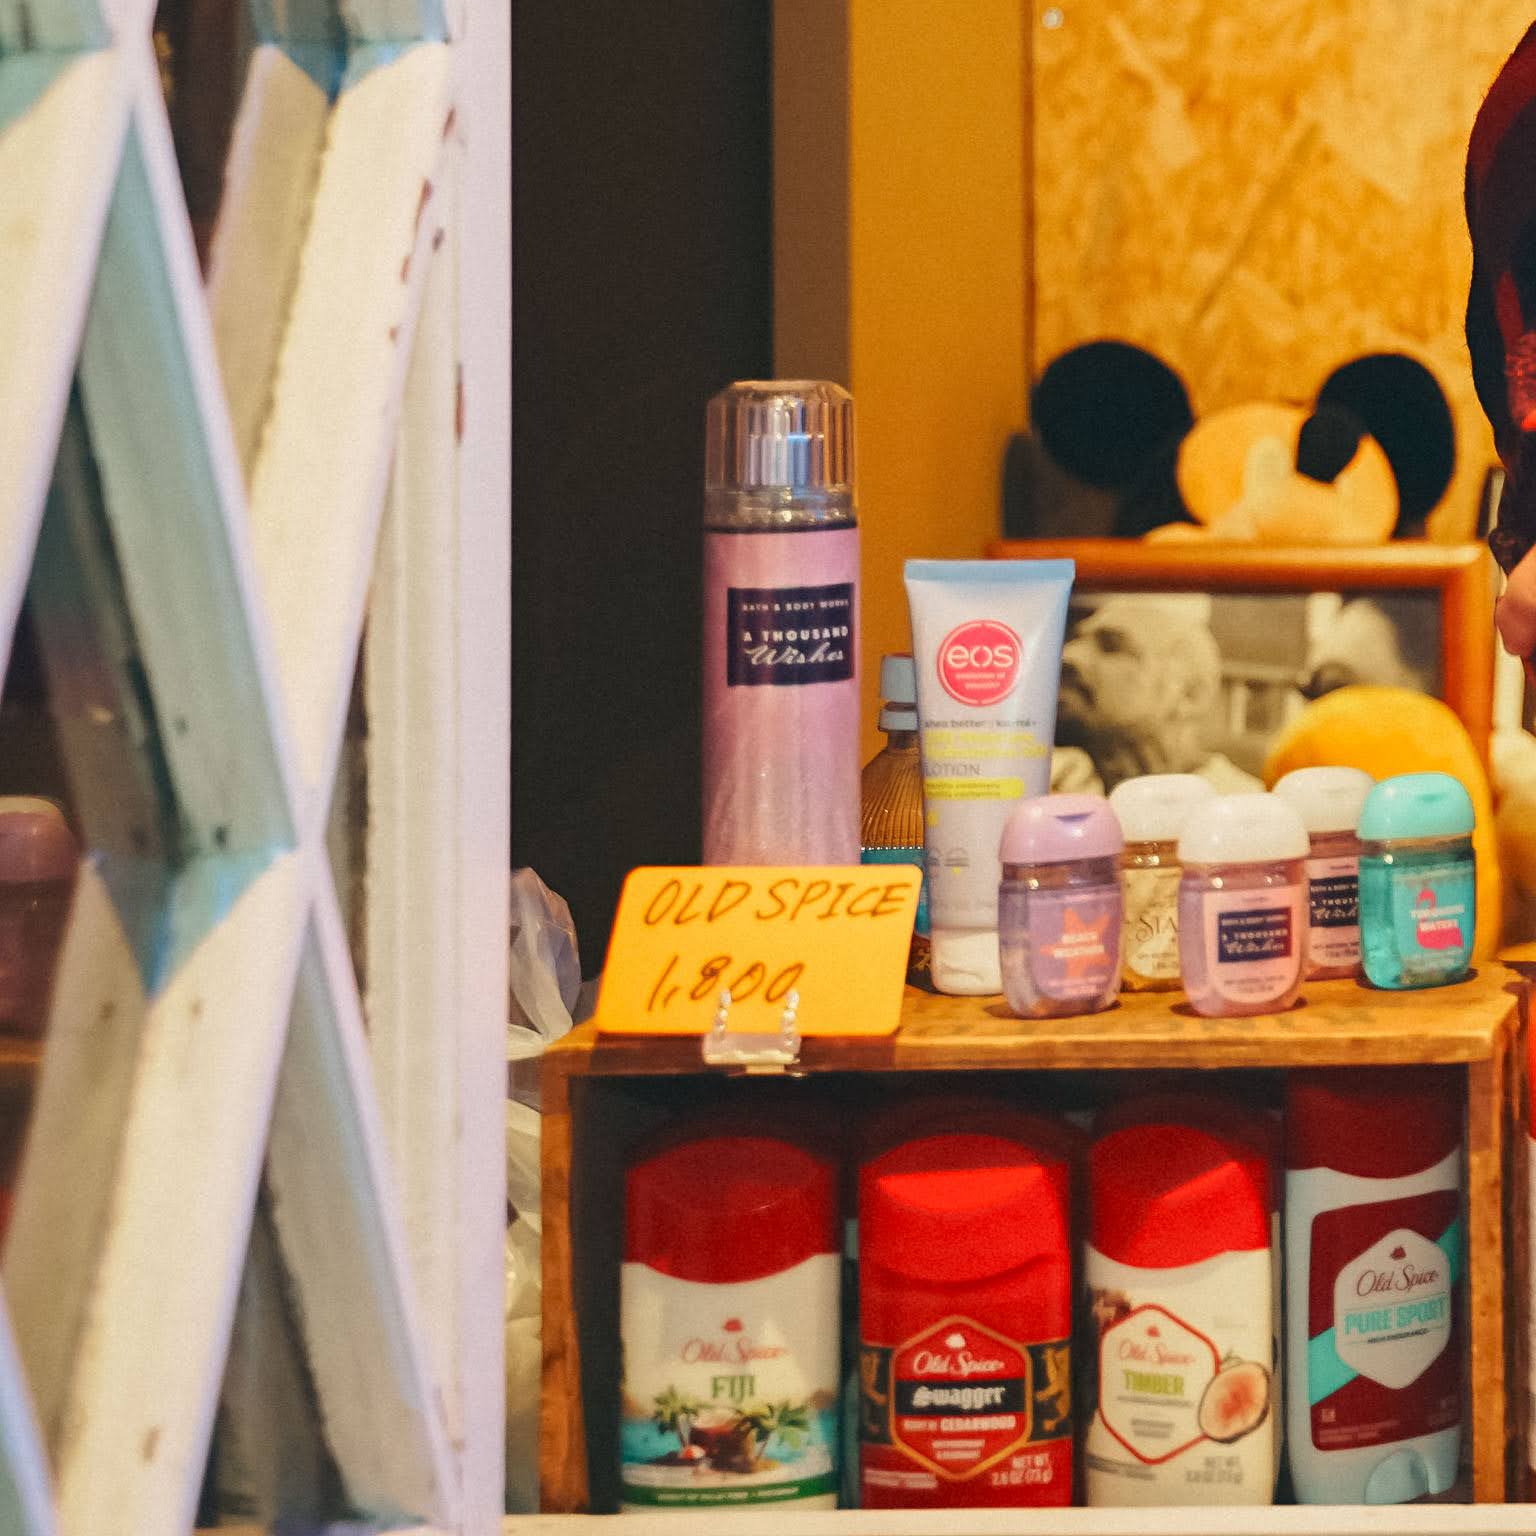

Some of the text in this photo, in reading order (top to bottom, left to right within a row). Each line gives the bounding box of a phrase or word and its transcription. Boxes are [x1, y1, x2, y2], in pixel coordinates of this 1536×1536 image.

[743, 625, 849, 642] A THOUSAND
[744, 641, 844, 666] Wishes
[946, 645, 1014, 669] eos
[925, 763, 981, 777] LOTION
[645, 878, 911, 926] OLD SPICE
[648, 955, 805, 1012] 1,800
[1357, 1264, 1441, 1297] Old Spice
[1344, 1295, 1448, 1336] PURE SPORT
[682, 1337, 726, 1365] Old
[913, 1350, 1004, 1377] Old Spice
[711, 1375, 756, 1404] FIJI
[1122, 1368, 1186, 1397] TIMBER
